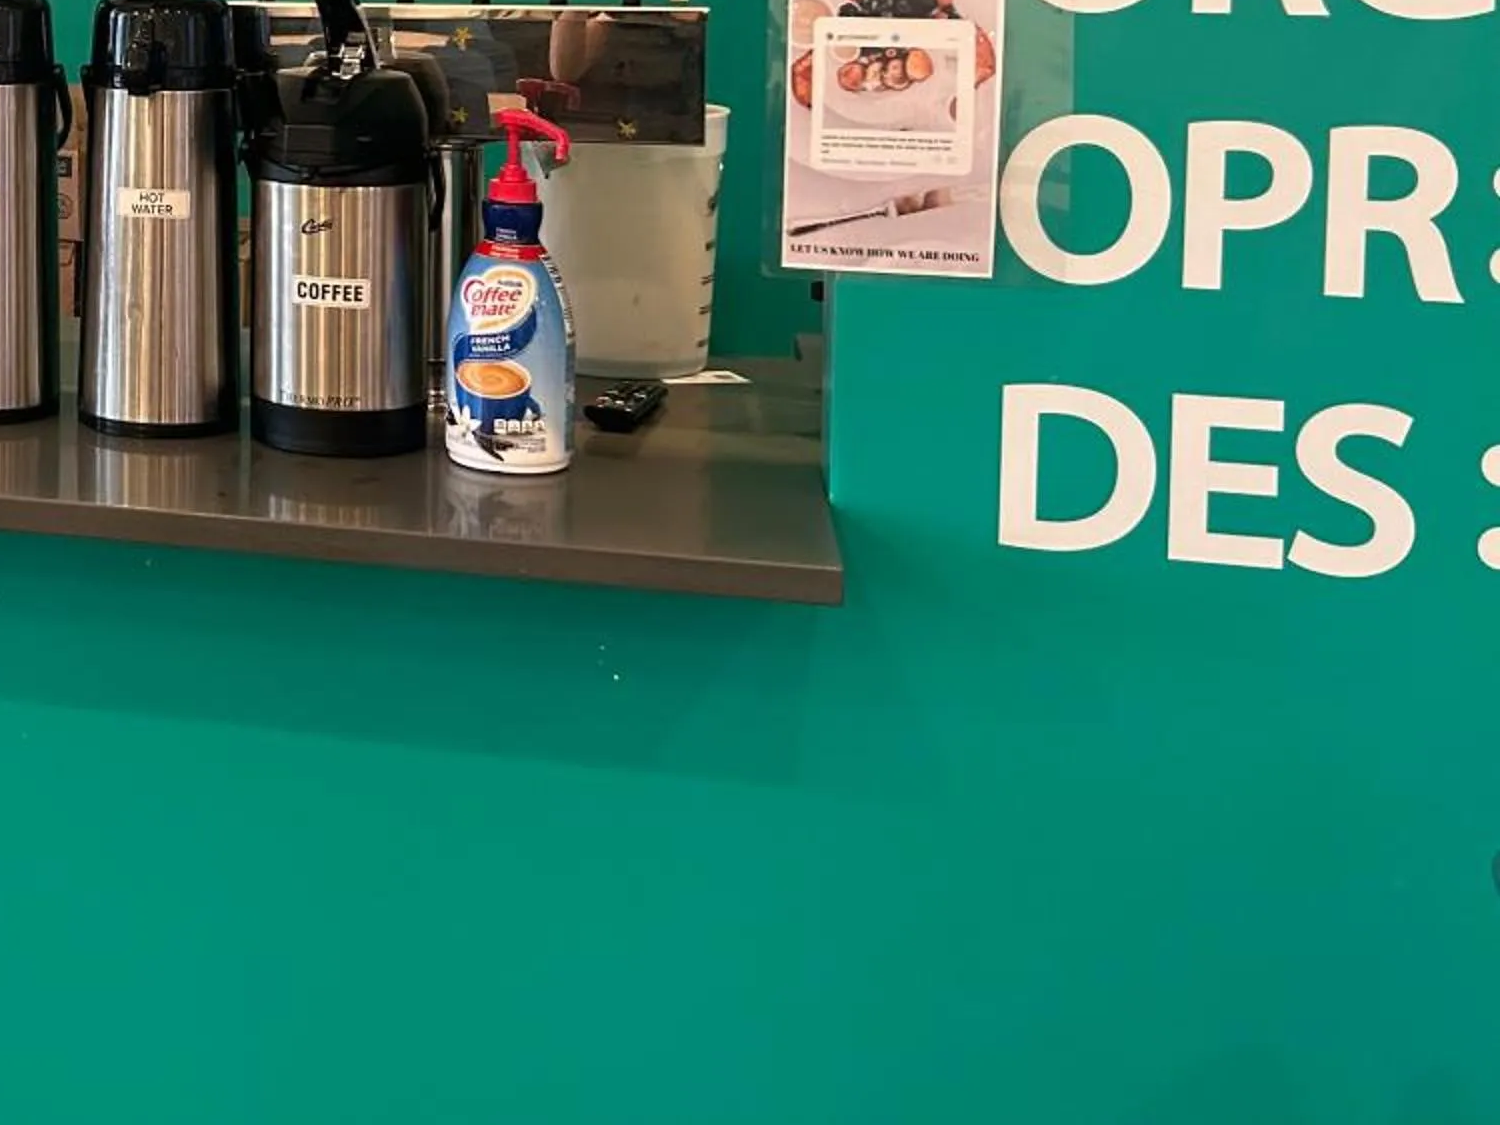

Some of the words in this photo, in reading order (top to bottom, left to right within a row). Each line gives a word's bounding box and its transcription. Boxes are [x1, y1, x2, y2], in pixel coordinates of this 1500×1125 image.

[139, 192, 165, 203] HOT
[131, 204, 173, 216] WATER
[790, 243, 812, 254] LET
[829, 246, 865, 257] KNOW
[866, 248, 894, 259] HOW
[897, 249, 915, 260] WE
[916, 250, 940, 262] ARE
[941, 251, 980, 263] DOING
[297, 281, 364, 302] COFFEE
[463, 279, 522, 304] Coffee
